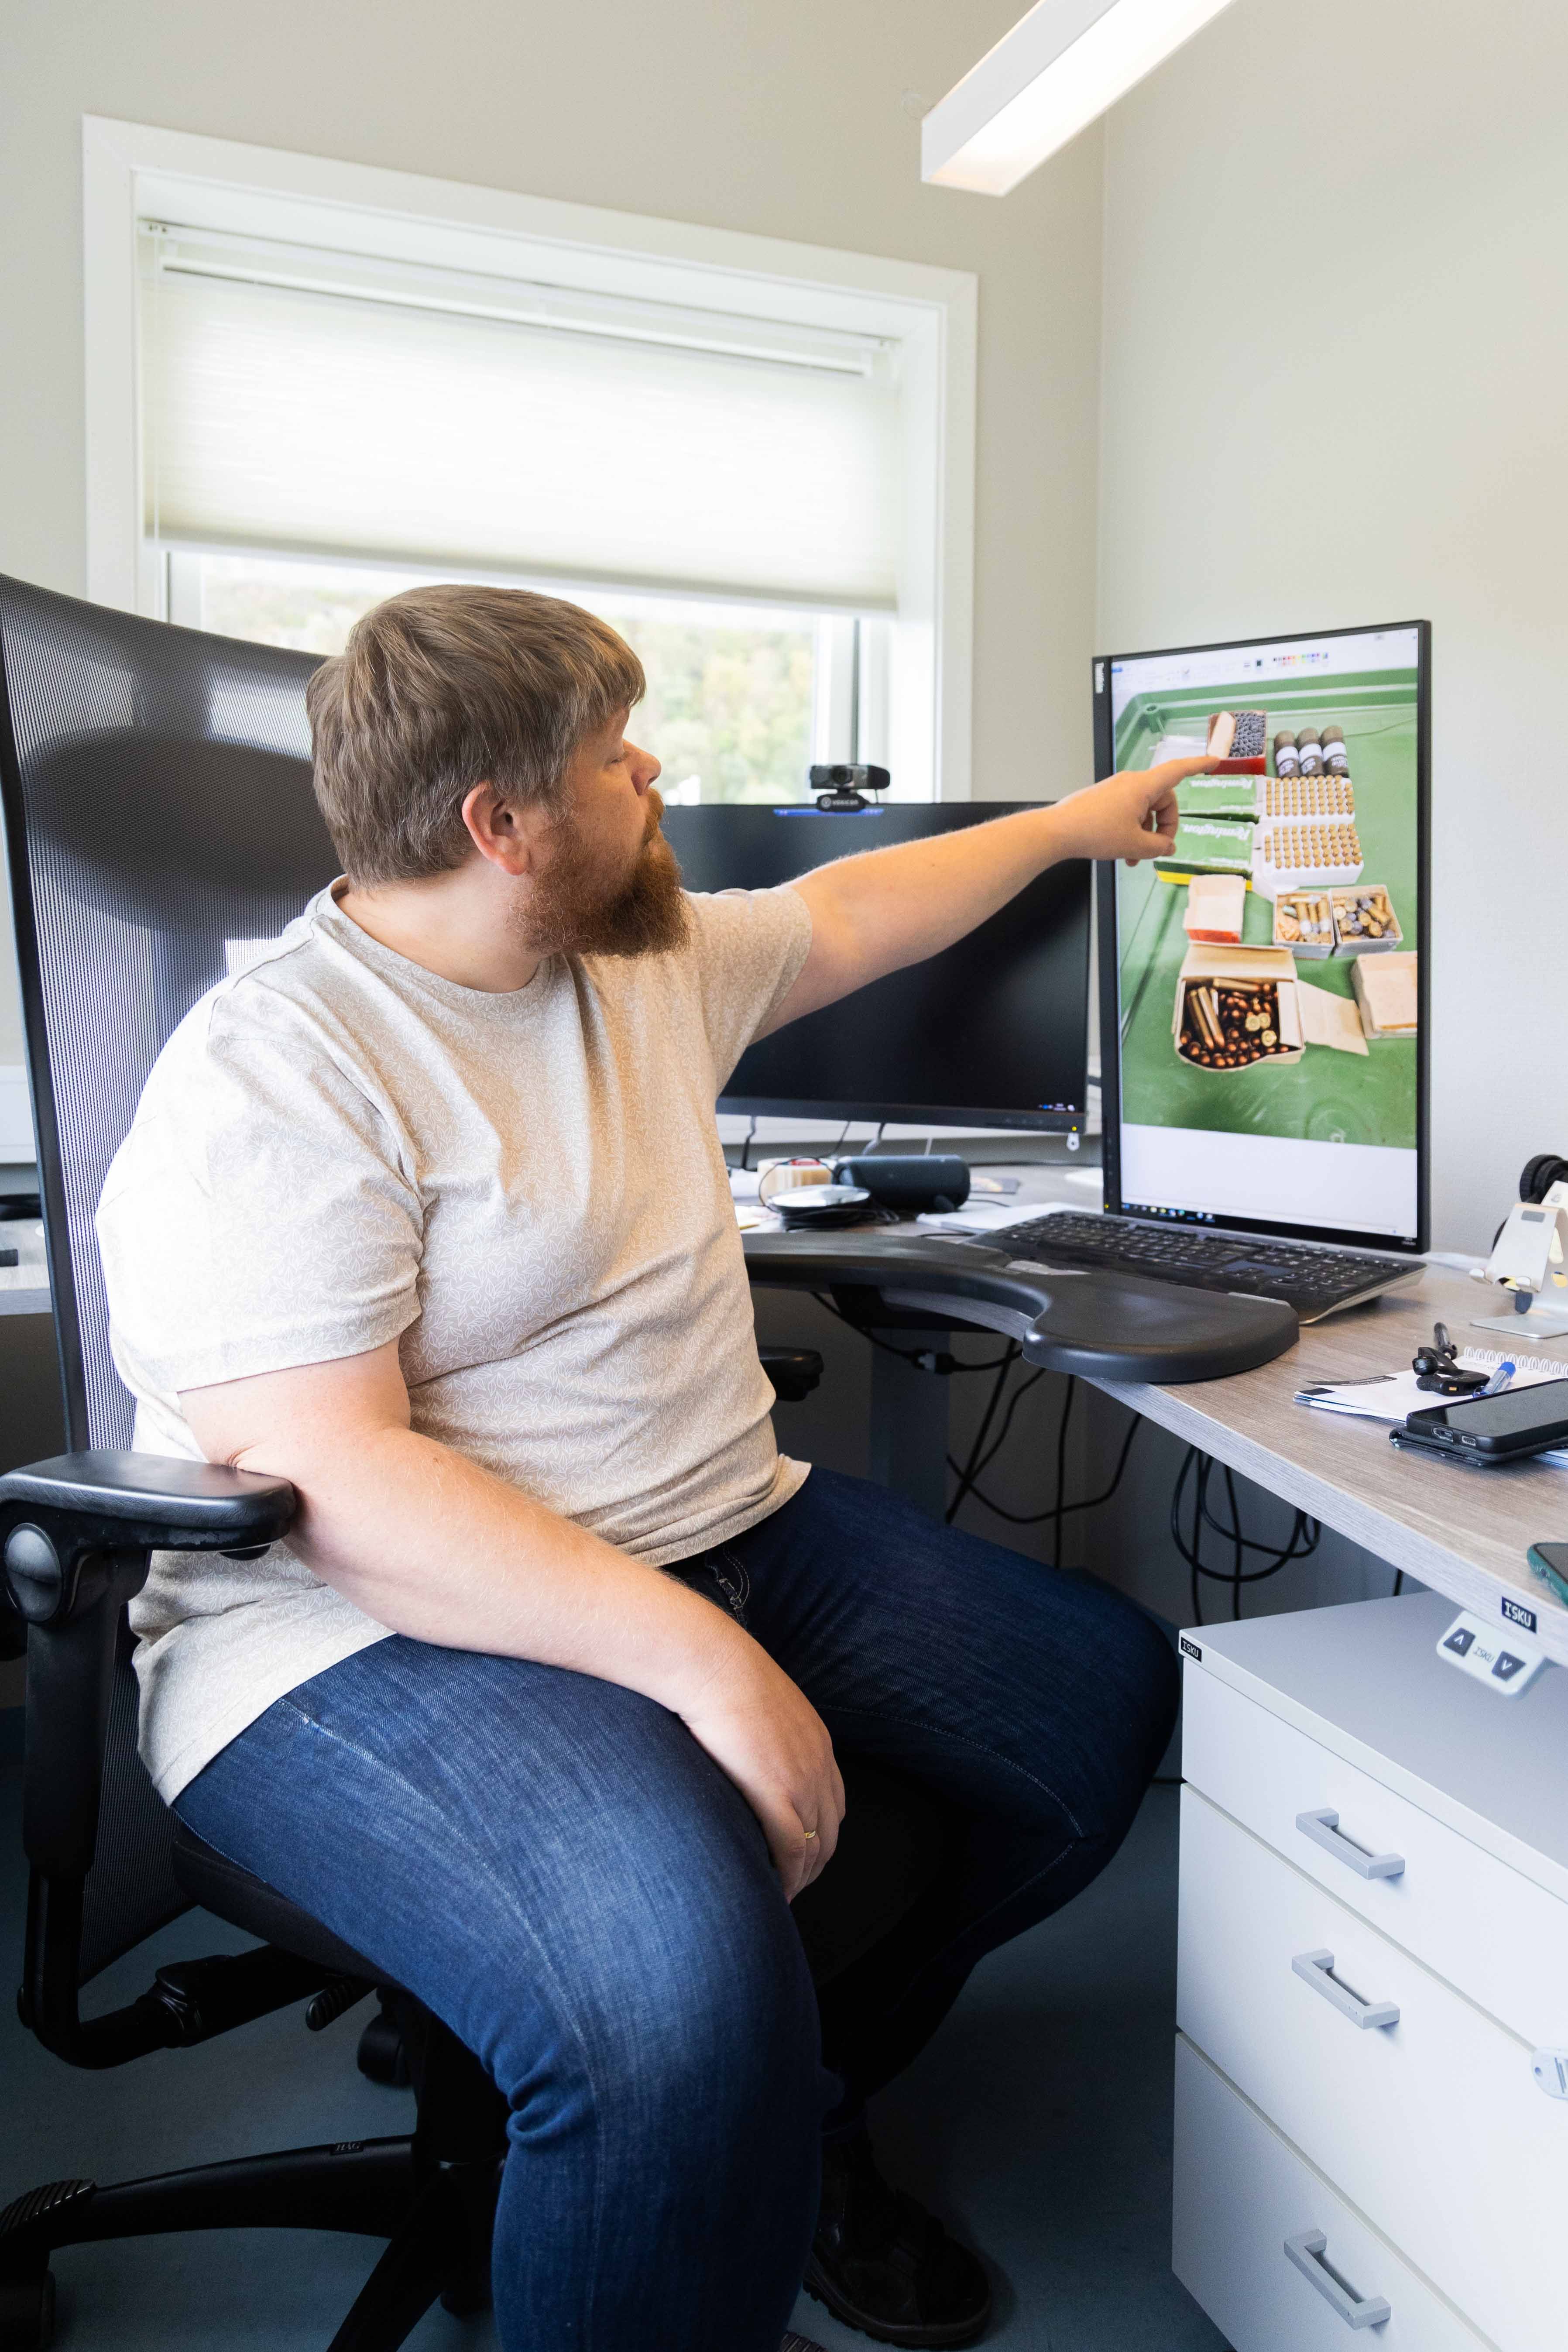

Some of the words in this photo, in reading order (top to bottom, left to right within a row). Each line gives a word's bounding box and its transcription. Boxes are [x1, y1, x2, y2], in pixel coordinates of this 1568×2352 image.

[1182, 823, 1251, 841] Remington
[1504, 1601, 1531, 1627] ISKU
[1182, 1640, 1199, 1657] ISKU
[1473, 1646, 1495, 1662] ISKU
